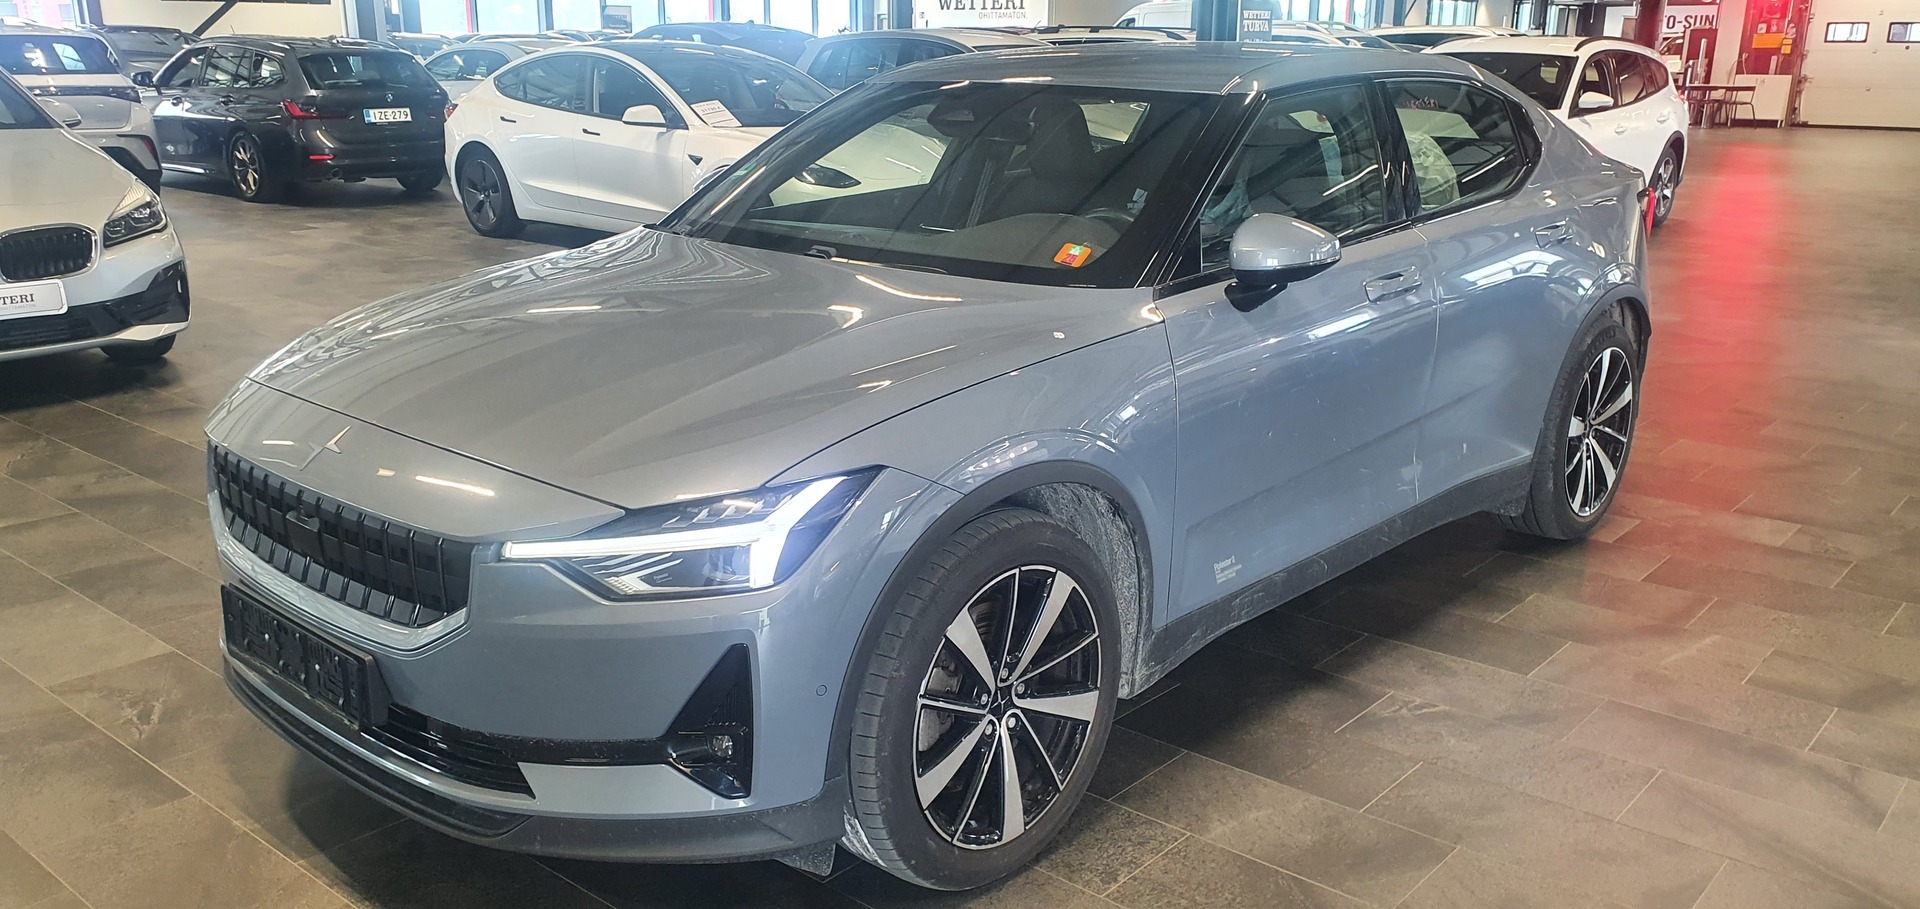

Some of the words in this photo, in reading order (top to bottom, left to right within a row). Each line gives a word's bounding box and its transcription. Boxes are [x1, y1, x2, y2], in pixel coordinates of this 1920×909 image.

[939, 0, 1025, 10] WETTERI
[1243, 20, 1270, 31] TURVA
[373, 110, 409, 120] IZE-279
